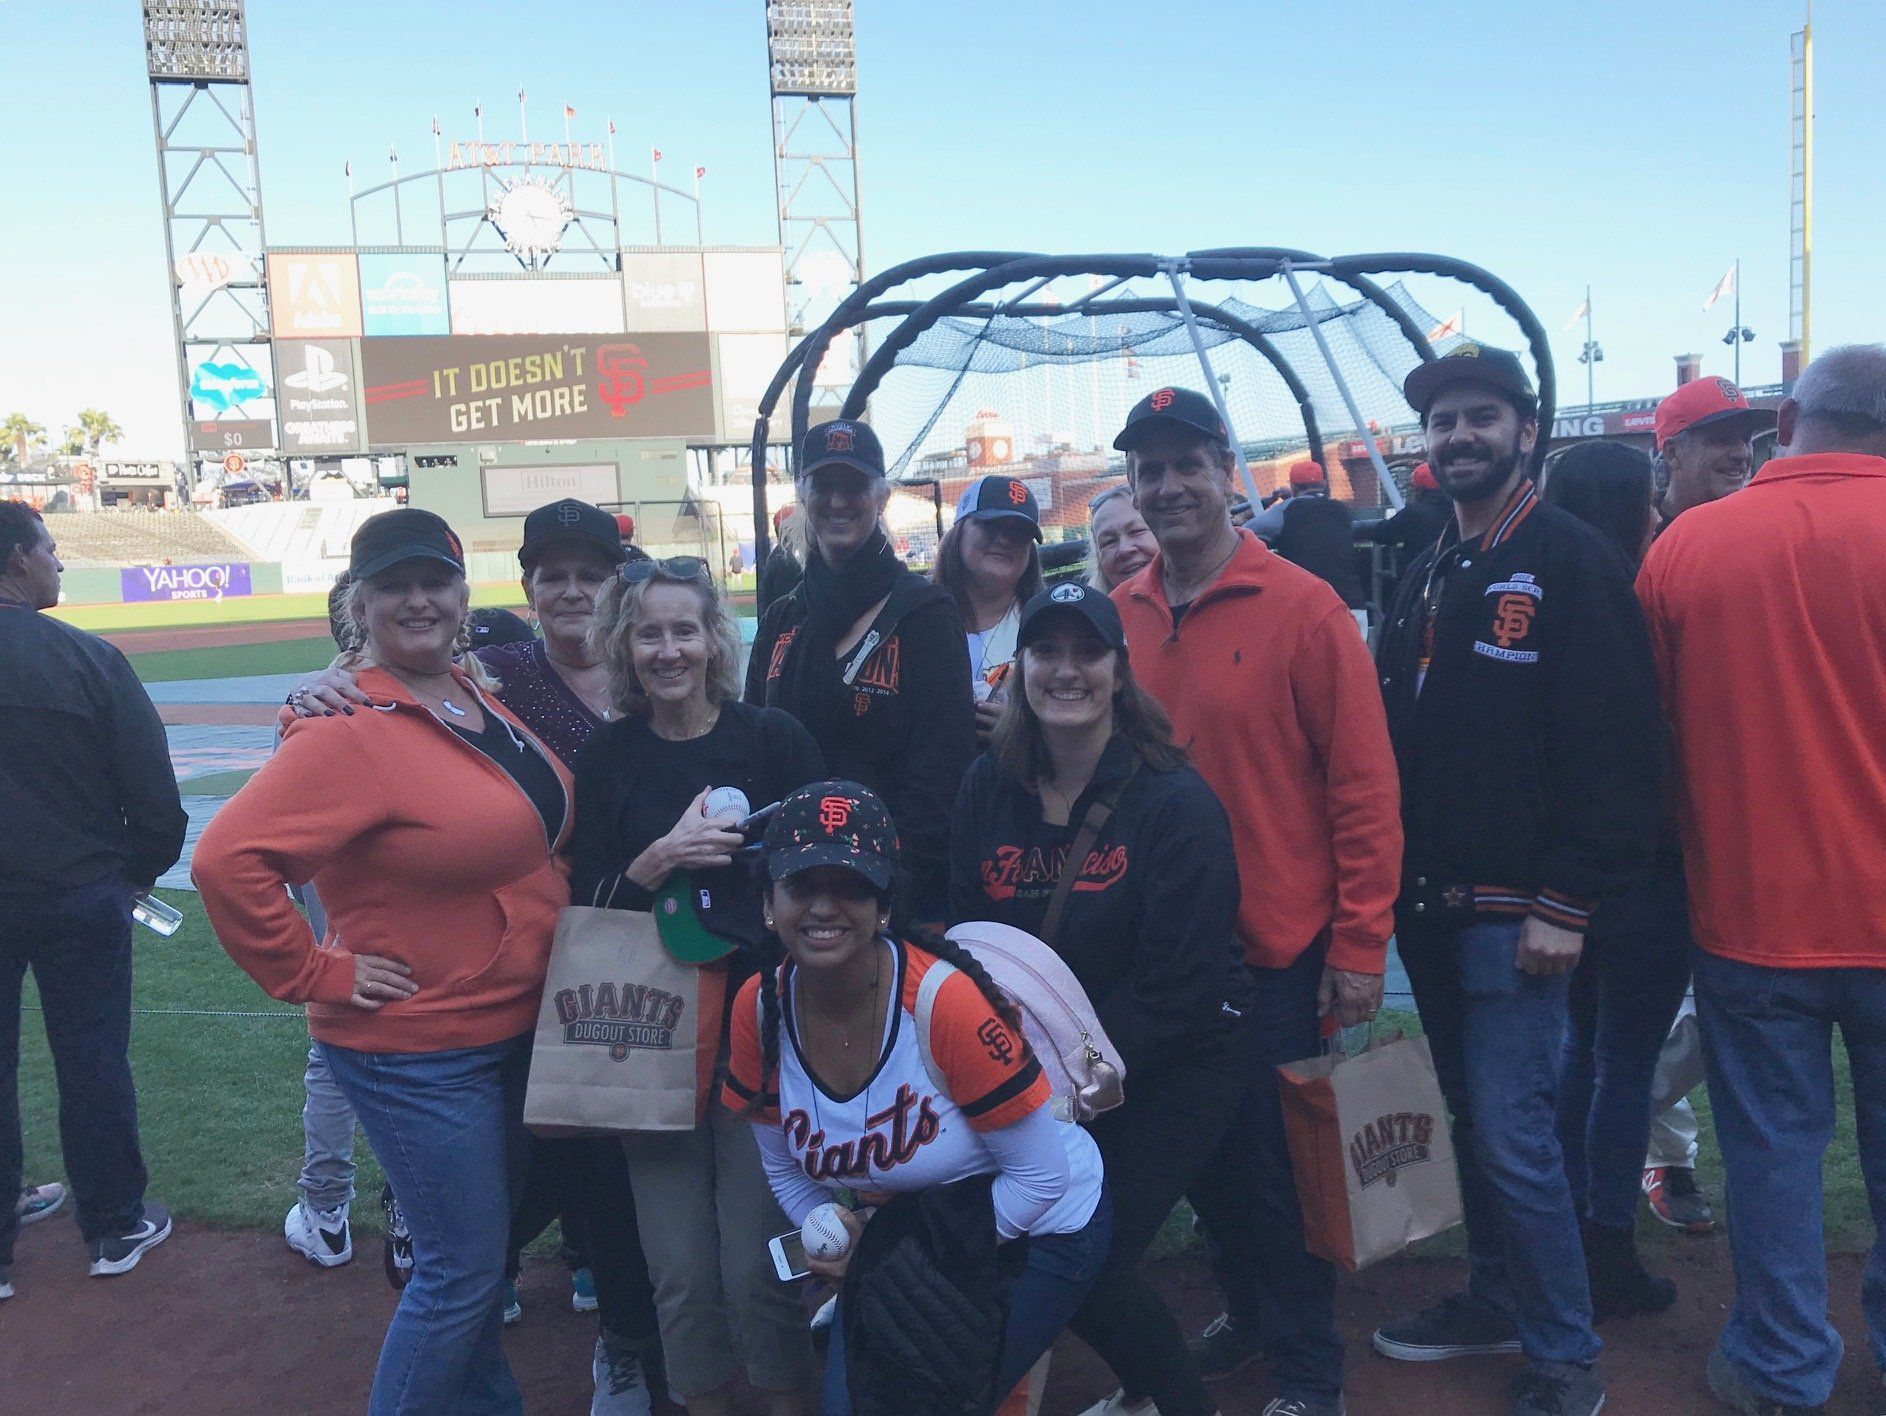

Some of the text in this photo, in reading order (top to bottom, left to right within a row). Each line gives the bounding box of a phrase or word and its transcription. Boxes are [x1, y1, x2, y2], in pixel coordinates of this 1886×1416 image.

[446, 141, 607, 172] AT&T PARK
[433, 344, 588, 399] IT DOESN'T
[596, 342, 648, 418] SF
[449, 384, 589, 433] GET MORE
[1151, 388, 1175, 413] SF
[224, 432, 243, 447] $0
[526, 474, 577, 489] Hilton
[1008, 480, 1029, 505] SF
[143, 565, 231, 592] YAHOO!
[171, 589, 208, 600] SPORTS
[1493, 593, 1536, 648] SF
[819, 796, 853, 836] SF
[553, 982, 686, 1032] GIANTS
[575, 1022, 666, 1044] DUGOUT STORE
[977, 1017, 1014, 1066] SF
